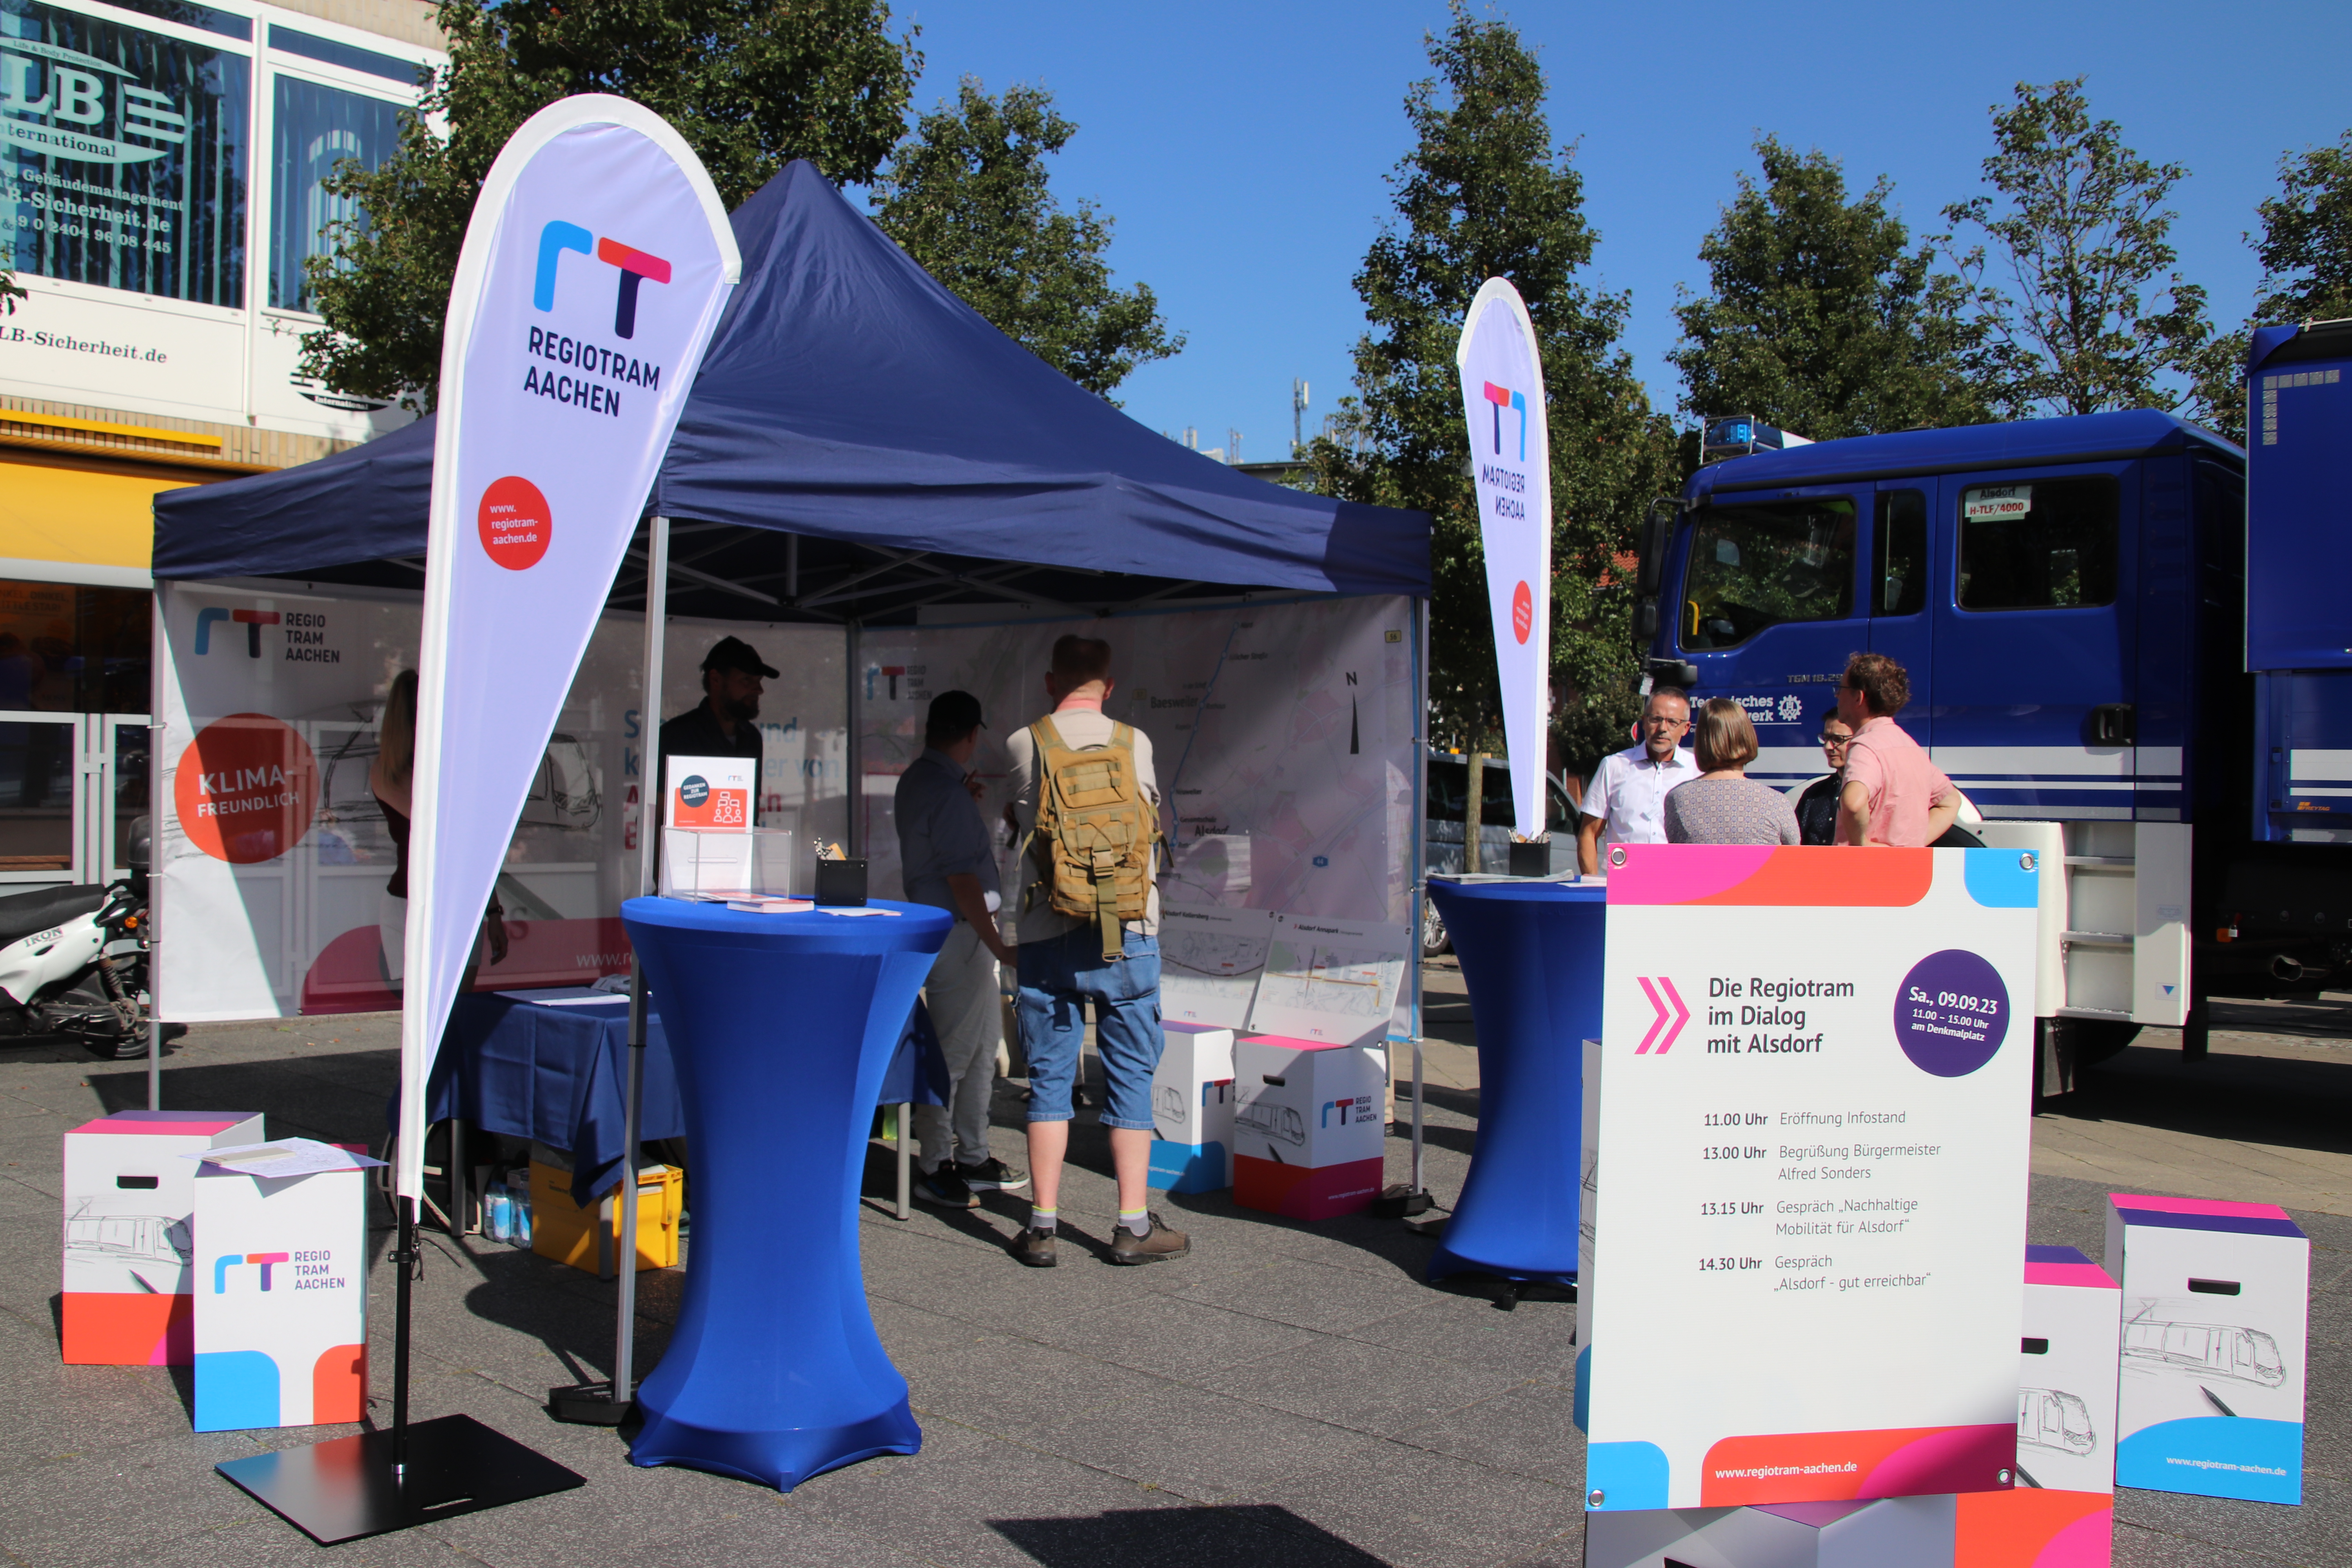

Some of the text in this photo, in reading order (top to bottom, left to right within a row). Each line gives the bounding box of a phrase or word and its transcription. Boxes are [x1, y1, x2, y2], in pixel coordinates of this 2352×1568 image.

[14, 40, 29, 49] Life
[41, 47, 60, 58] Body
[63, 53, 102, 67] Protection
[23, 169, 183, 211] Gebäudemanagement
[0, 187, 171, 232] B-Sicherheit.de
[33, 218, 44, 230] 0
[49, 221, 89, 238] 2404
[94, 229, 113, 243] 96
[119, 234, 138, 247] 08
[143, 240, 171, 253] 445
[528, 326, 660, 391] REGIOTRAM
[524, 366, 620, 417] AACHEN
[1980, 486, 2016, 499] Alsdorf
[490, 505, 517, 514] www.
[1970, 503, 2024, 515] H-TLF/4000
[492, 518, 538, 531] regiotram-
[493, 532, 537, 545] aachen.de
[286, 612, 326, 628] REGIO
[286, 630, 323, 645] TRAM
[286, 648, 340, 664] AACHEN
[1346, 671, 1357, 686] N
[1787, 673, 1843, 683] TGM 18.29
[1151, 696, 1198, 709] Baesweiler
[795, 759, 839, 778] von
[198, 764, 294, 796] KLIMA-
[683, 791, 708, 800] REGIOTRAM
[197, 792, 299, 817] FREUNDLICH
[1195, 826, 1229, 836] Alsdorf
[24, 927, 64, 947] IRON
[1710, 977, 1854, 1003] Die Regiotram
[1909, 986, 1998, 1014] Sa., 09.09.23
[1709, 1005, 1806, 1030] im Dialog
[1913, 1008, 1937, 1020] 11.00
[1947, 1014, 1972, 1026] 15.00
[1973, 1018, 1989, 1029] Uhr
[1911, 1023, 1985, 1042] am Denkmalplatz
[1708, 1033, 1824, 1053] mit Alsdorf
[1355, 1096, 1371, 1105] REGIO
[1355, 1105, 1370, 1114] TRAM
[1355, 1114, 1377, 1123] AACHEN
[1704, 1111, 1906, 1127] 11.00 Uhr Eröffnung Infostand
[1703, 1143, 1941, 1161] 13.00 Uhr Begrüßung Bürgermeister
[1778, 1166, 1871, 1180] Alfred Sonders
[1701, 1198, 1918, 1216] 13.15 Uhr Gespräch „Nachhaltige
[1776, 1219, 1909, 1235] Mobilität für Alsdorf“
[295, 1250, 330, 1262] REGIO
[1699, 1254, 1832, 1271] 14.30 Uhr Gespräch
[295, 1264, 329, 1276] TRAM
[295, 1277, 345, 1290] AACHEN
[1774, 1276, 1826, 1292] „Alsdorf
[1839, 1277, 1860, 1292] gut
[1864, 1272, 1931, 1287] erreichbar“
[1715, 1461, 1857, 1479] www.regiotram-aachen.de
[2166, 1457, 2287, 1476] www.regiotram-aachen.de
